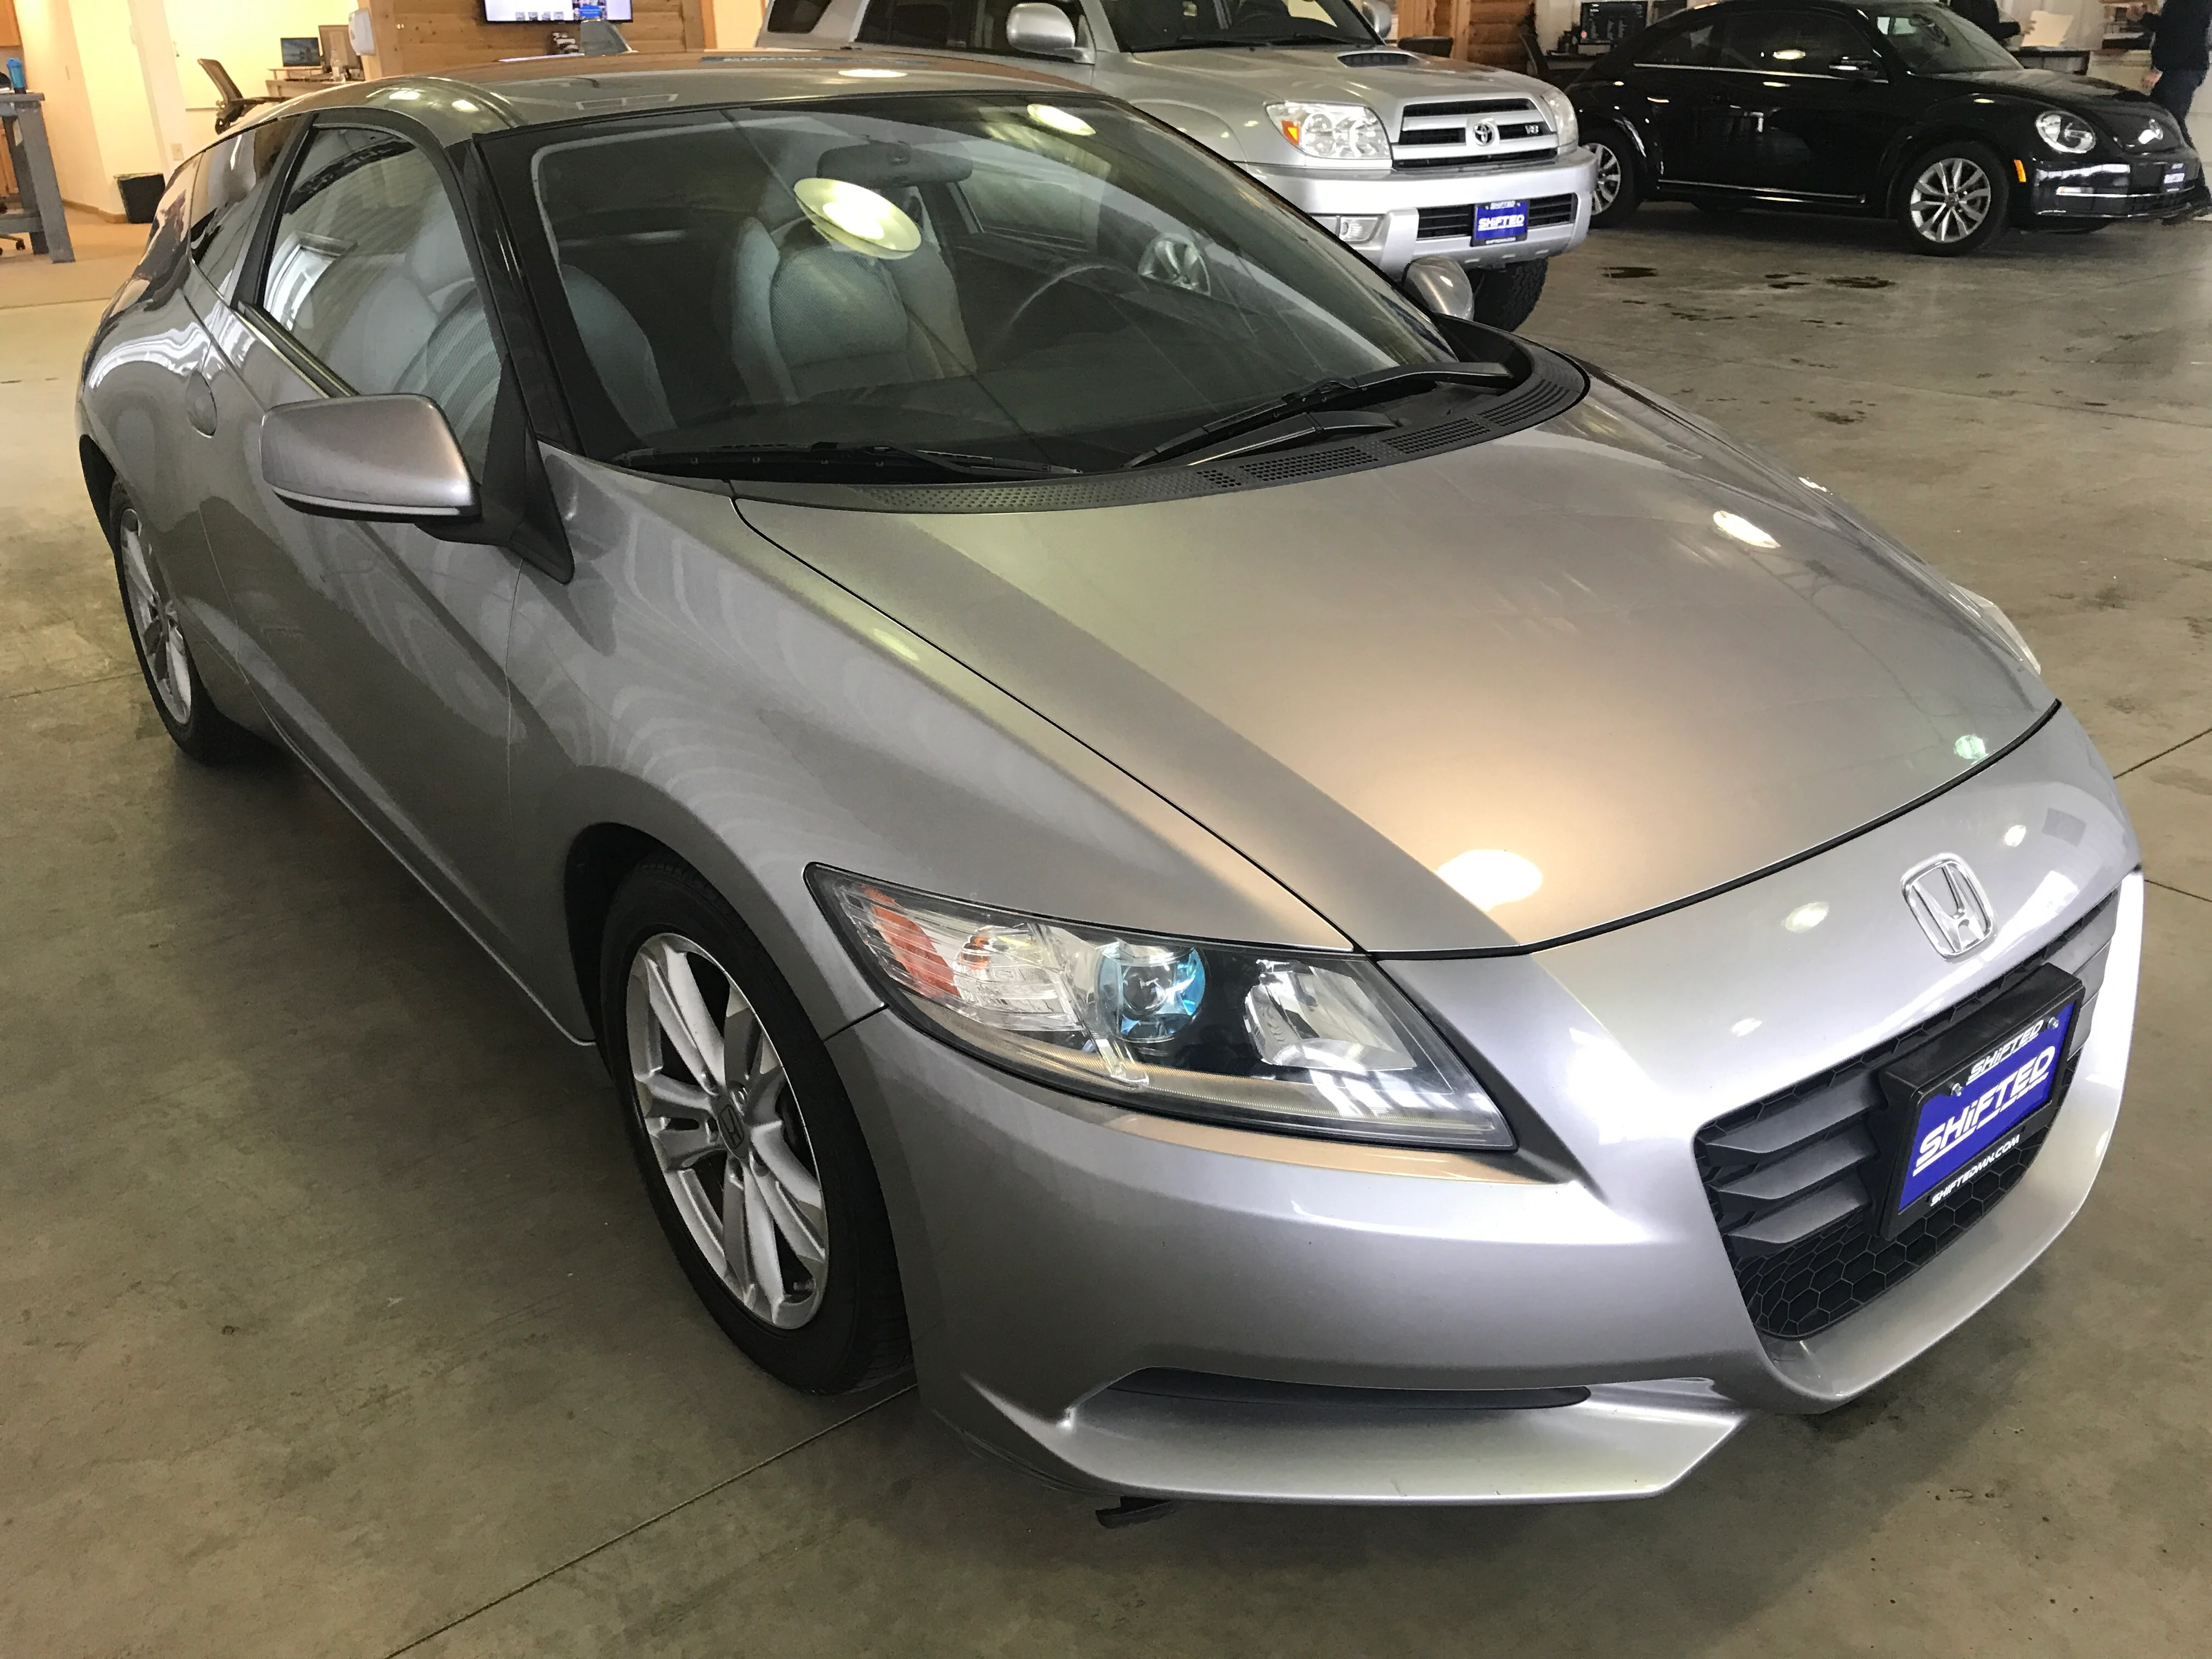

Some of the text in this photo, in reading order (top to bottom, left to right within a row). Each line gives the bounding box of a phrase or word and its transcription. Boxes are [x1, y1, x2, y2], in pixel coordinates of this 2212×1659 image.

[1966, 1020, 2044, 1086] SHiFTED
[1913, 1046, 2056, 1177] SHiFTED
[1930, 1134, 2020, 1207] SHIFTEDMN.COM
